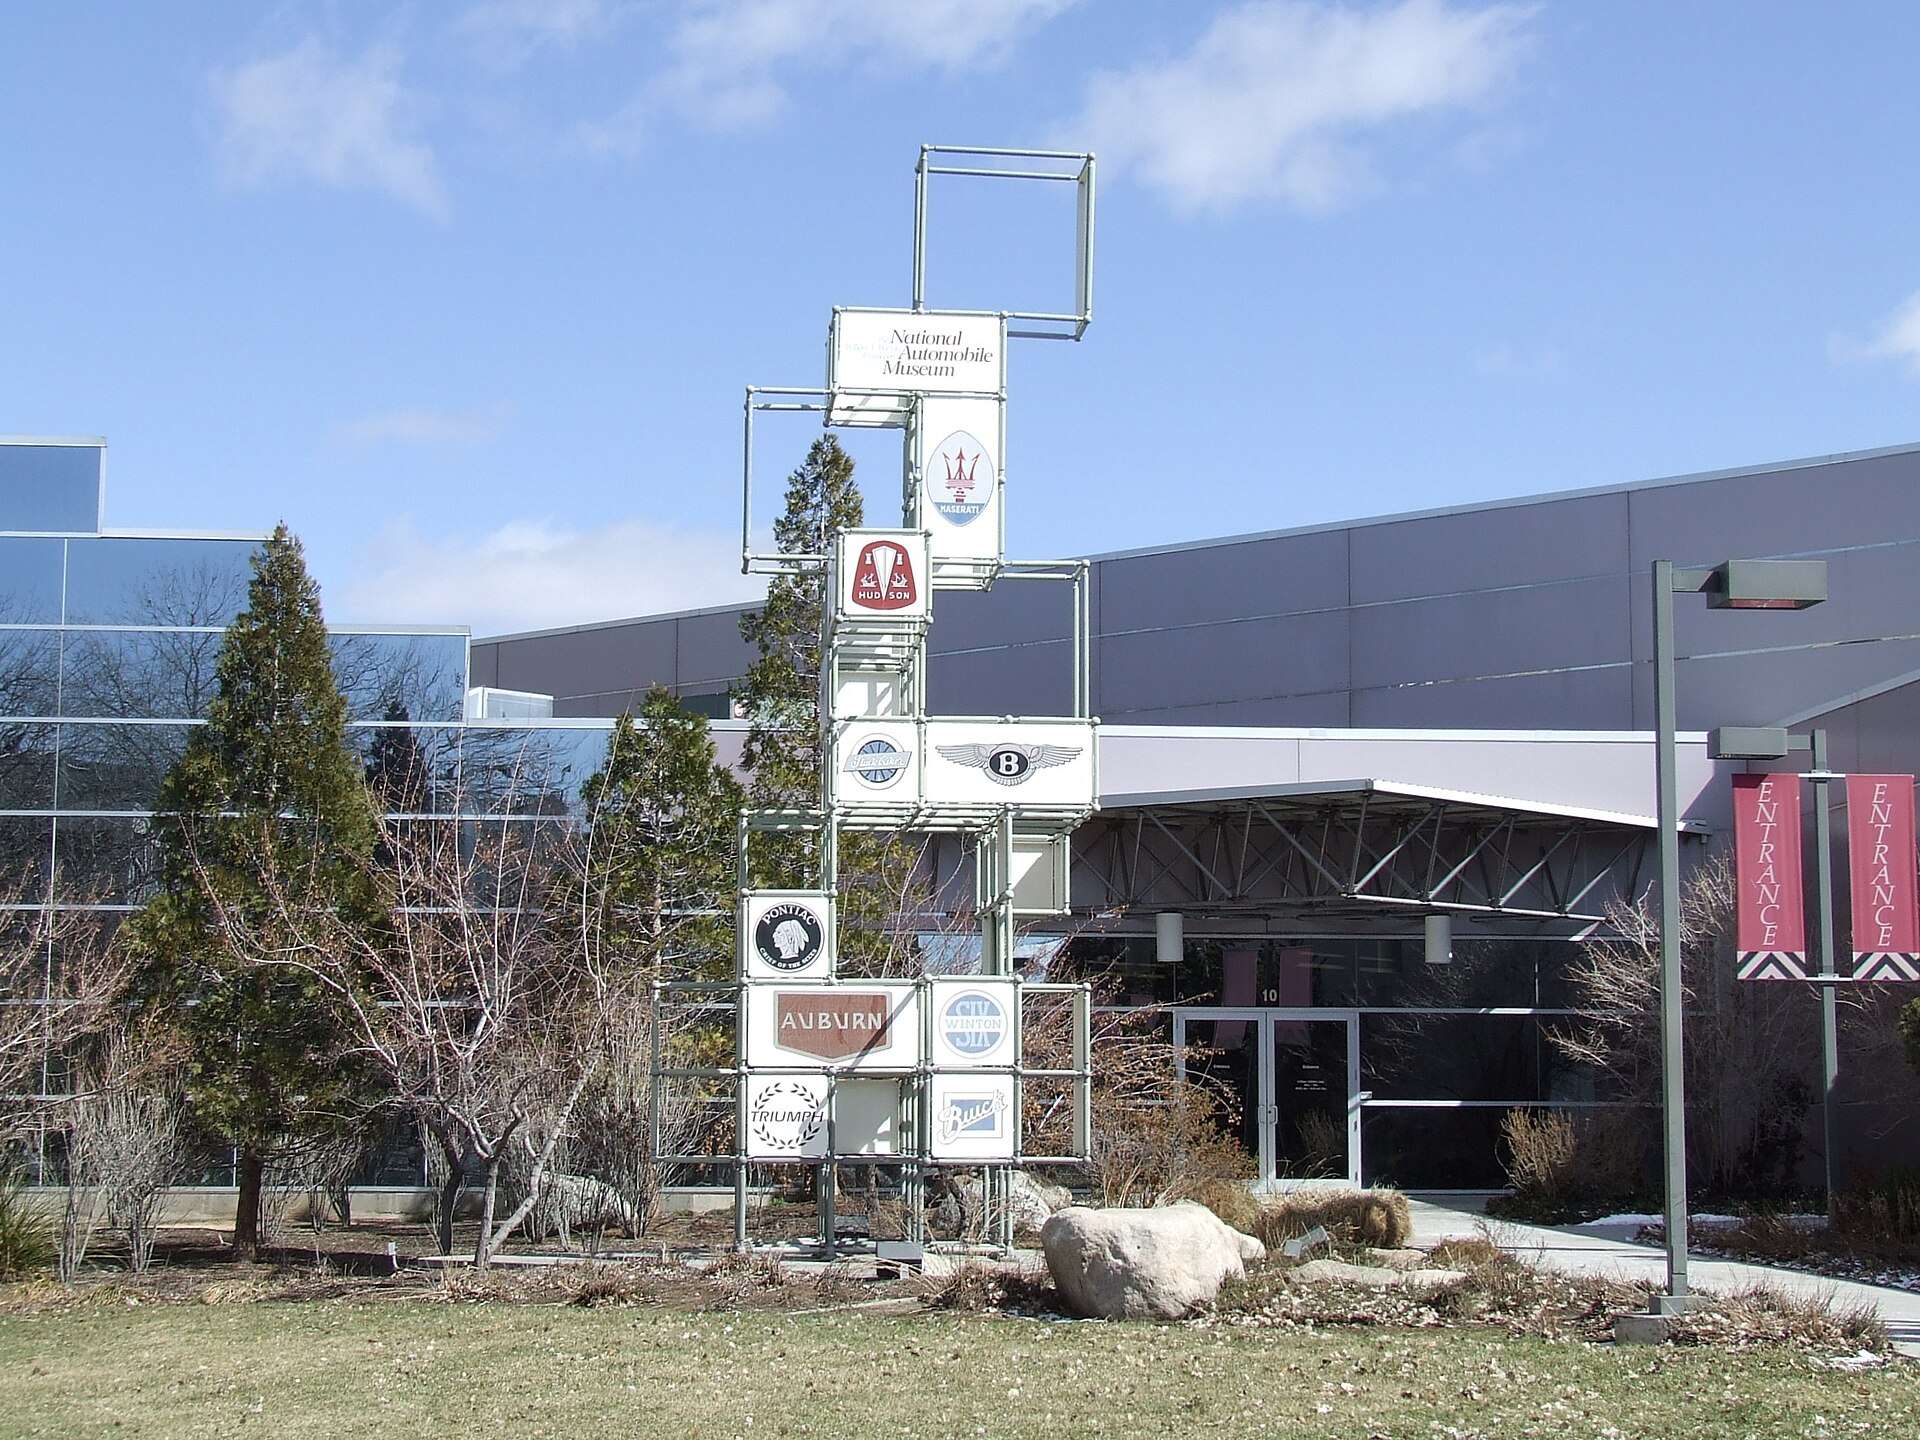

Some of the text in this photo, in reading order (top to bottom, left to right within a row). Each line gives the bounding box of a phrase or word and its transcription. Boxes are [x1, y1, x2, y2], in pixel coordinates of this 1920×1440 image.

[890, 329, 963, 346] National
[898, 345, 994, 363] Automobile
[882, 360, 955, 377] Museum
[940, 505, 979, 514] MASERATI
[999, 752, 1019, 775] B
[1754, 782, 1780, 946] ENTRANCE
[1868, 783, 1896, 947] ENTRANCE
[762, 904, 817, 926] PONTIAC
[1261, 988, 1278, 1002] 10
[781, 1011, 883, 1030] AUBURN
[945, 1018, 1001, 1030] WINTON
[751, 1110, 825, 1123] TRIUMPH
